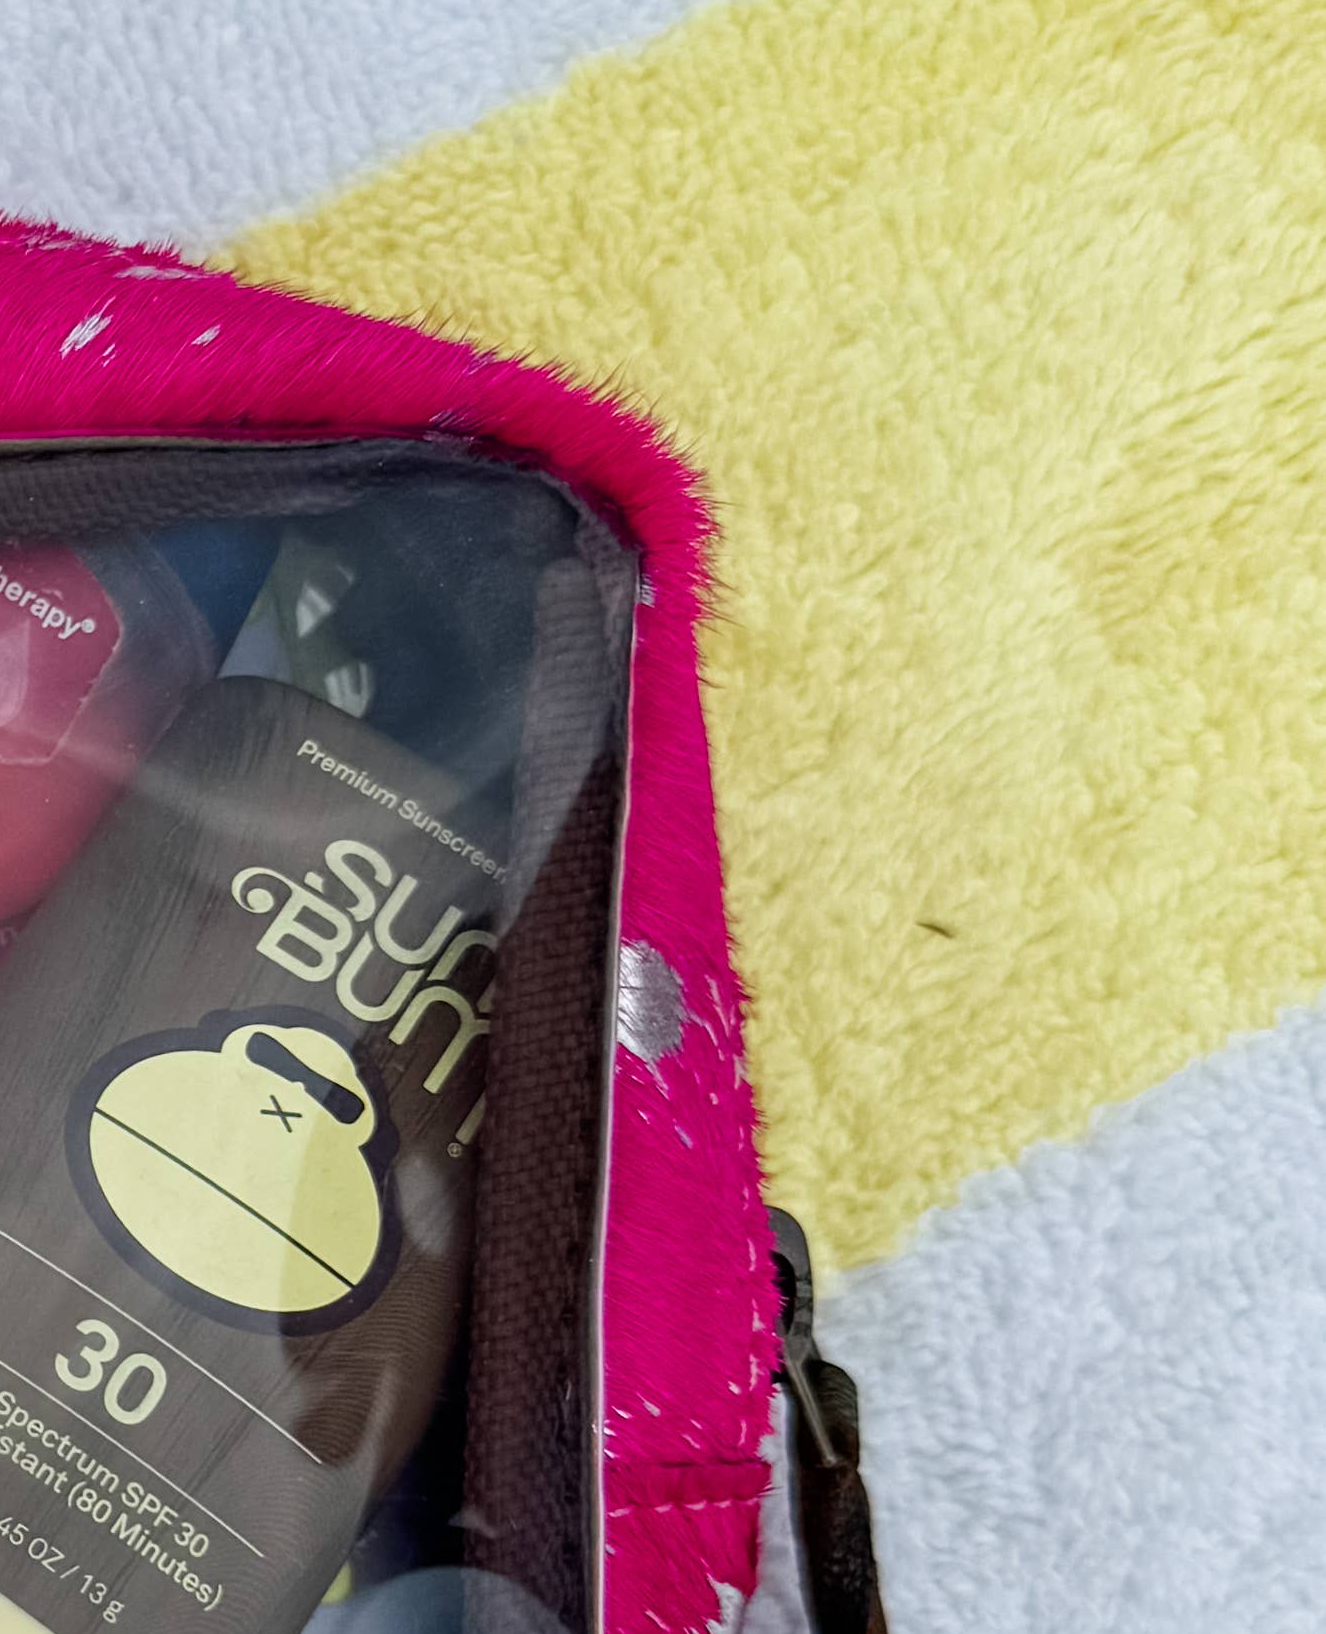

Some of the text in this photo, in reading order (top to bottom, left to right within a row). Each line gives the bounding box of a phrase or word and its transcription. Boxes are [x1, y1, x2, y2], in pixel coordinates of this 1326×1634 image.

[296, 738, 400, 811] Premium
[54, 1318, 168, 1425] 30
[67, 1481, 113, 1524] (80
[110, 1512, 223, 1612] Minutes)
[121, 1481, 179, 1529] SPF
[174, 1522, 209, 1558] 30
[27, 1537, 65, 1573] OZ
[59, 1565, 81, 1580] /
[79, 1574, 108, 1605] 13
[102, 1600, 126, 1625] g
